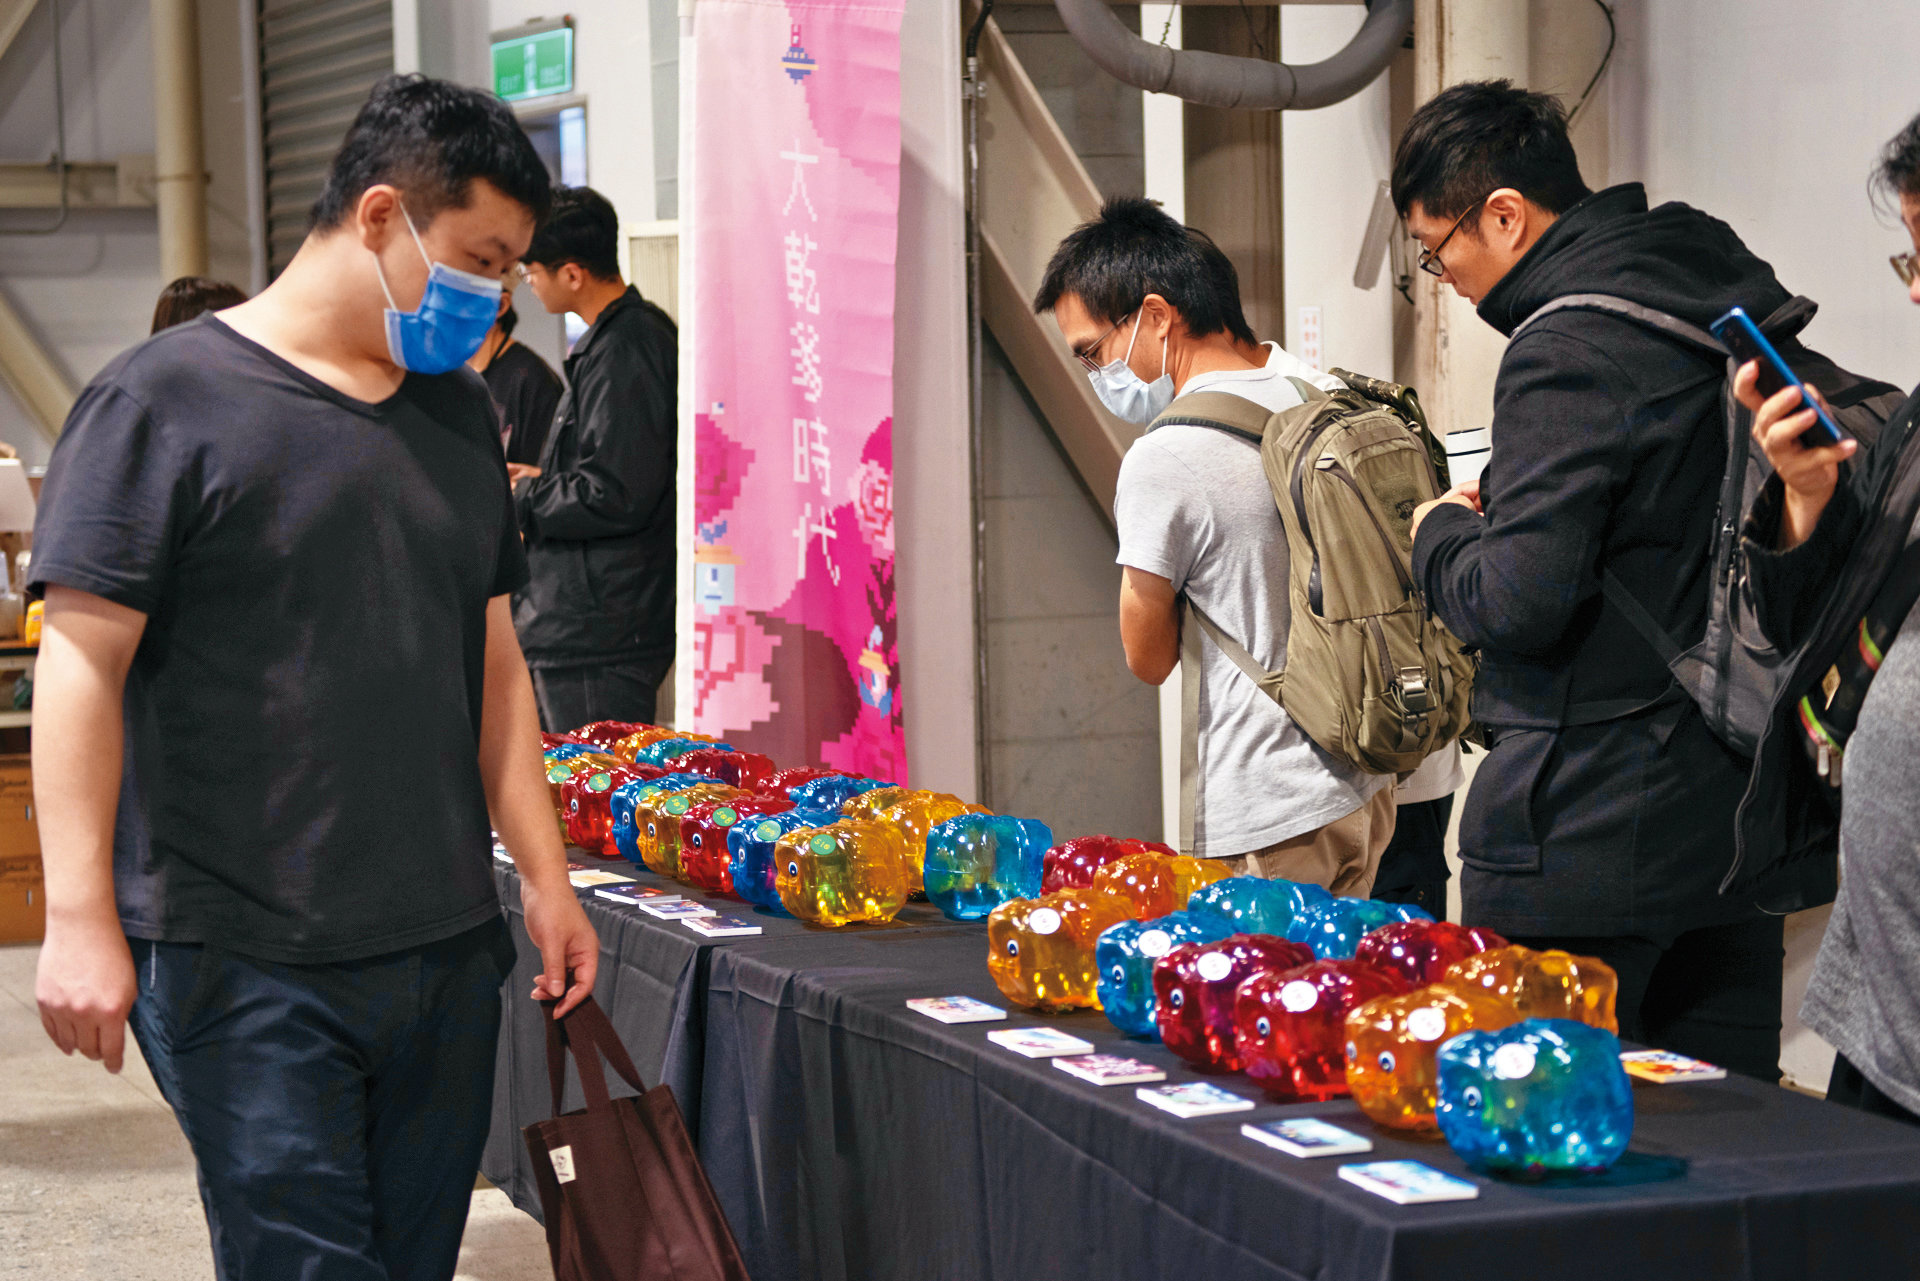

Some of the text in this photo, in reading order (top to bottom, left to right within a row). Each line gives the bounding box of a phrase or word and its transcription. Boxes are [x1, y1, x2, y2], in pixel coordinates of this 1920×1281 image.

[671, 798, 685, 811] S07
[716, 810, 734, 824] S08
[760, 824, 775, 837] S09
[814, 838, 830, 850] S10
